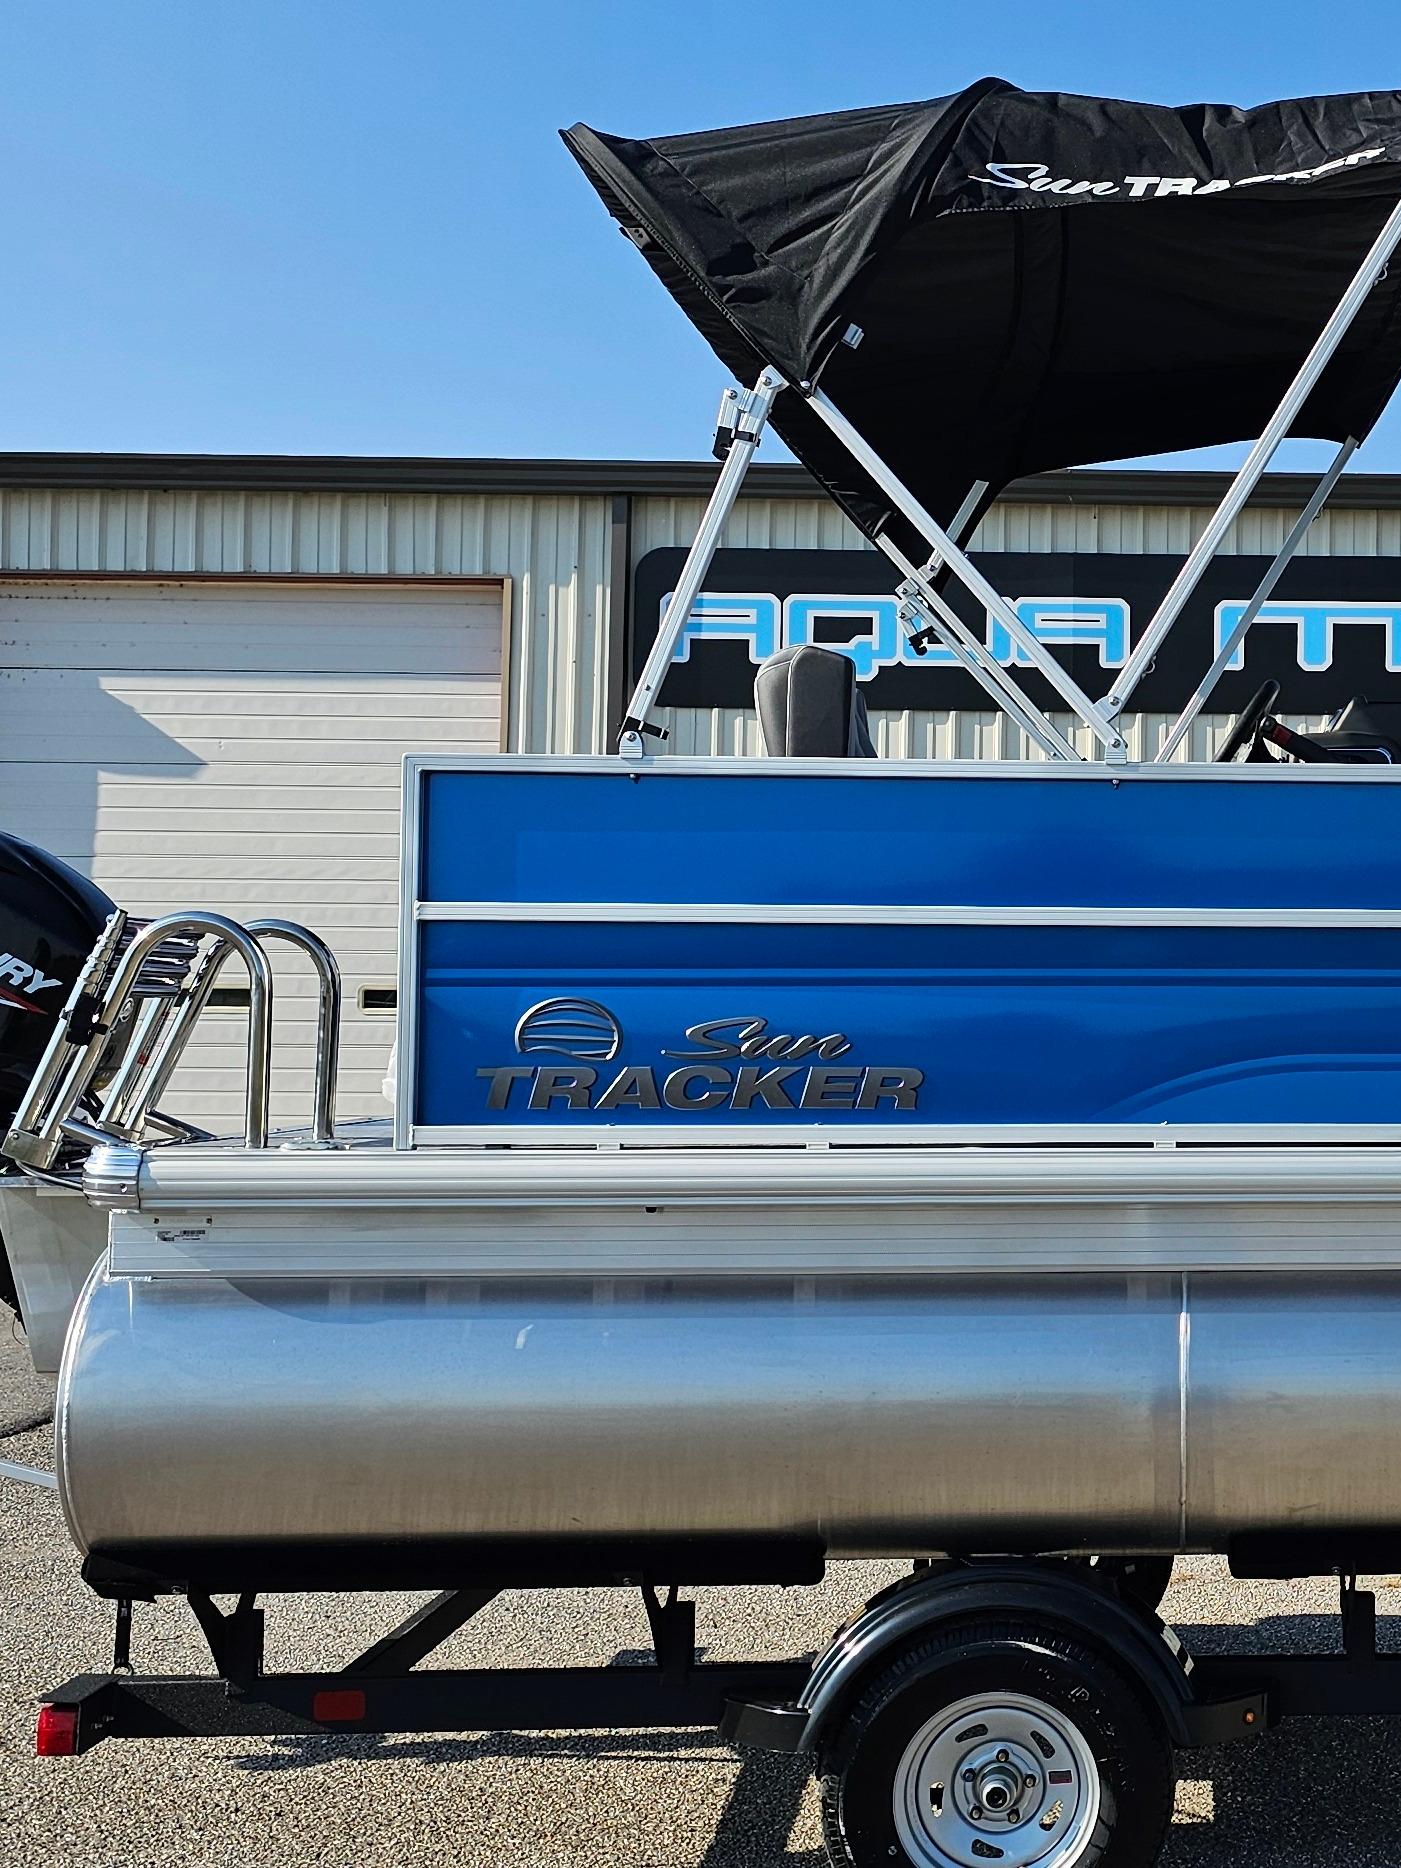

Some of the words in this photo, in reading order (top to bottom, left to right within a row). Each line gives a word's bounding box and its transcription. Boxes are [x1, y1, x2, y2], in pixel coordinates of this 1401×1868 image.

[967, 162, 1120, 196] Sun
[659, 592, 1131, 682] AQUA
[660, 1016, 853, 1061] Sun
[475, 1065, 924, 1111] TRACKER
